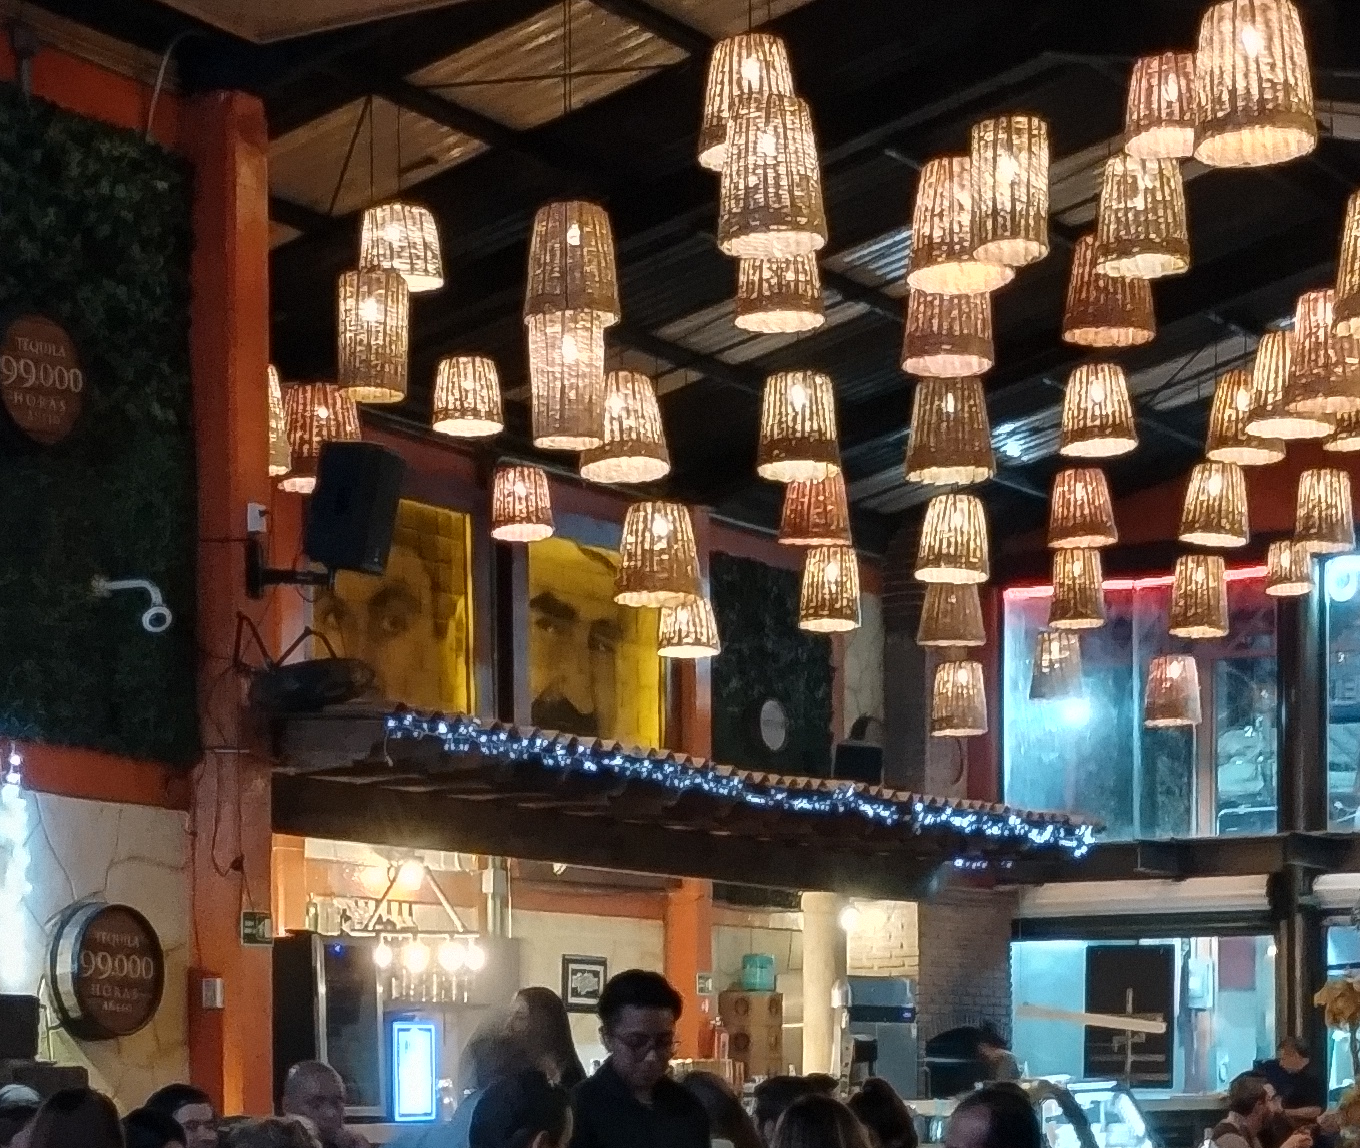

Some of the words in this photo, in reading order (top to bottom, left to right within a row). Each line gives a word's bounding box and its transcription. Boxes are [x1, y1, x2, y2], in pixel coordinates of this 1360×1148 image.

[16, 337, 66, 357] TEQUILA
[13, 391, 67, 412] HORAS
[95, 931, 141, 948] TEQUILA
[91, 983, 141, 999] HORAS
